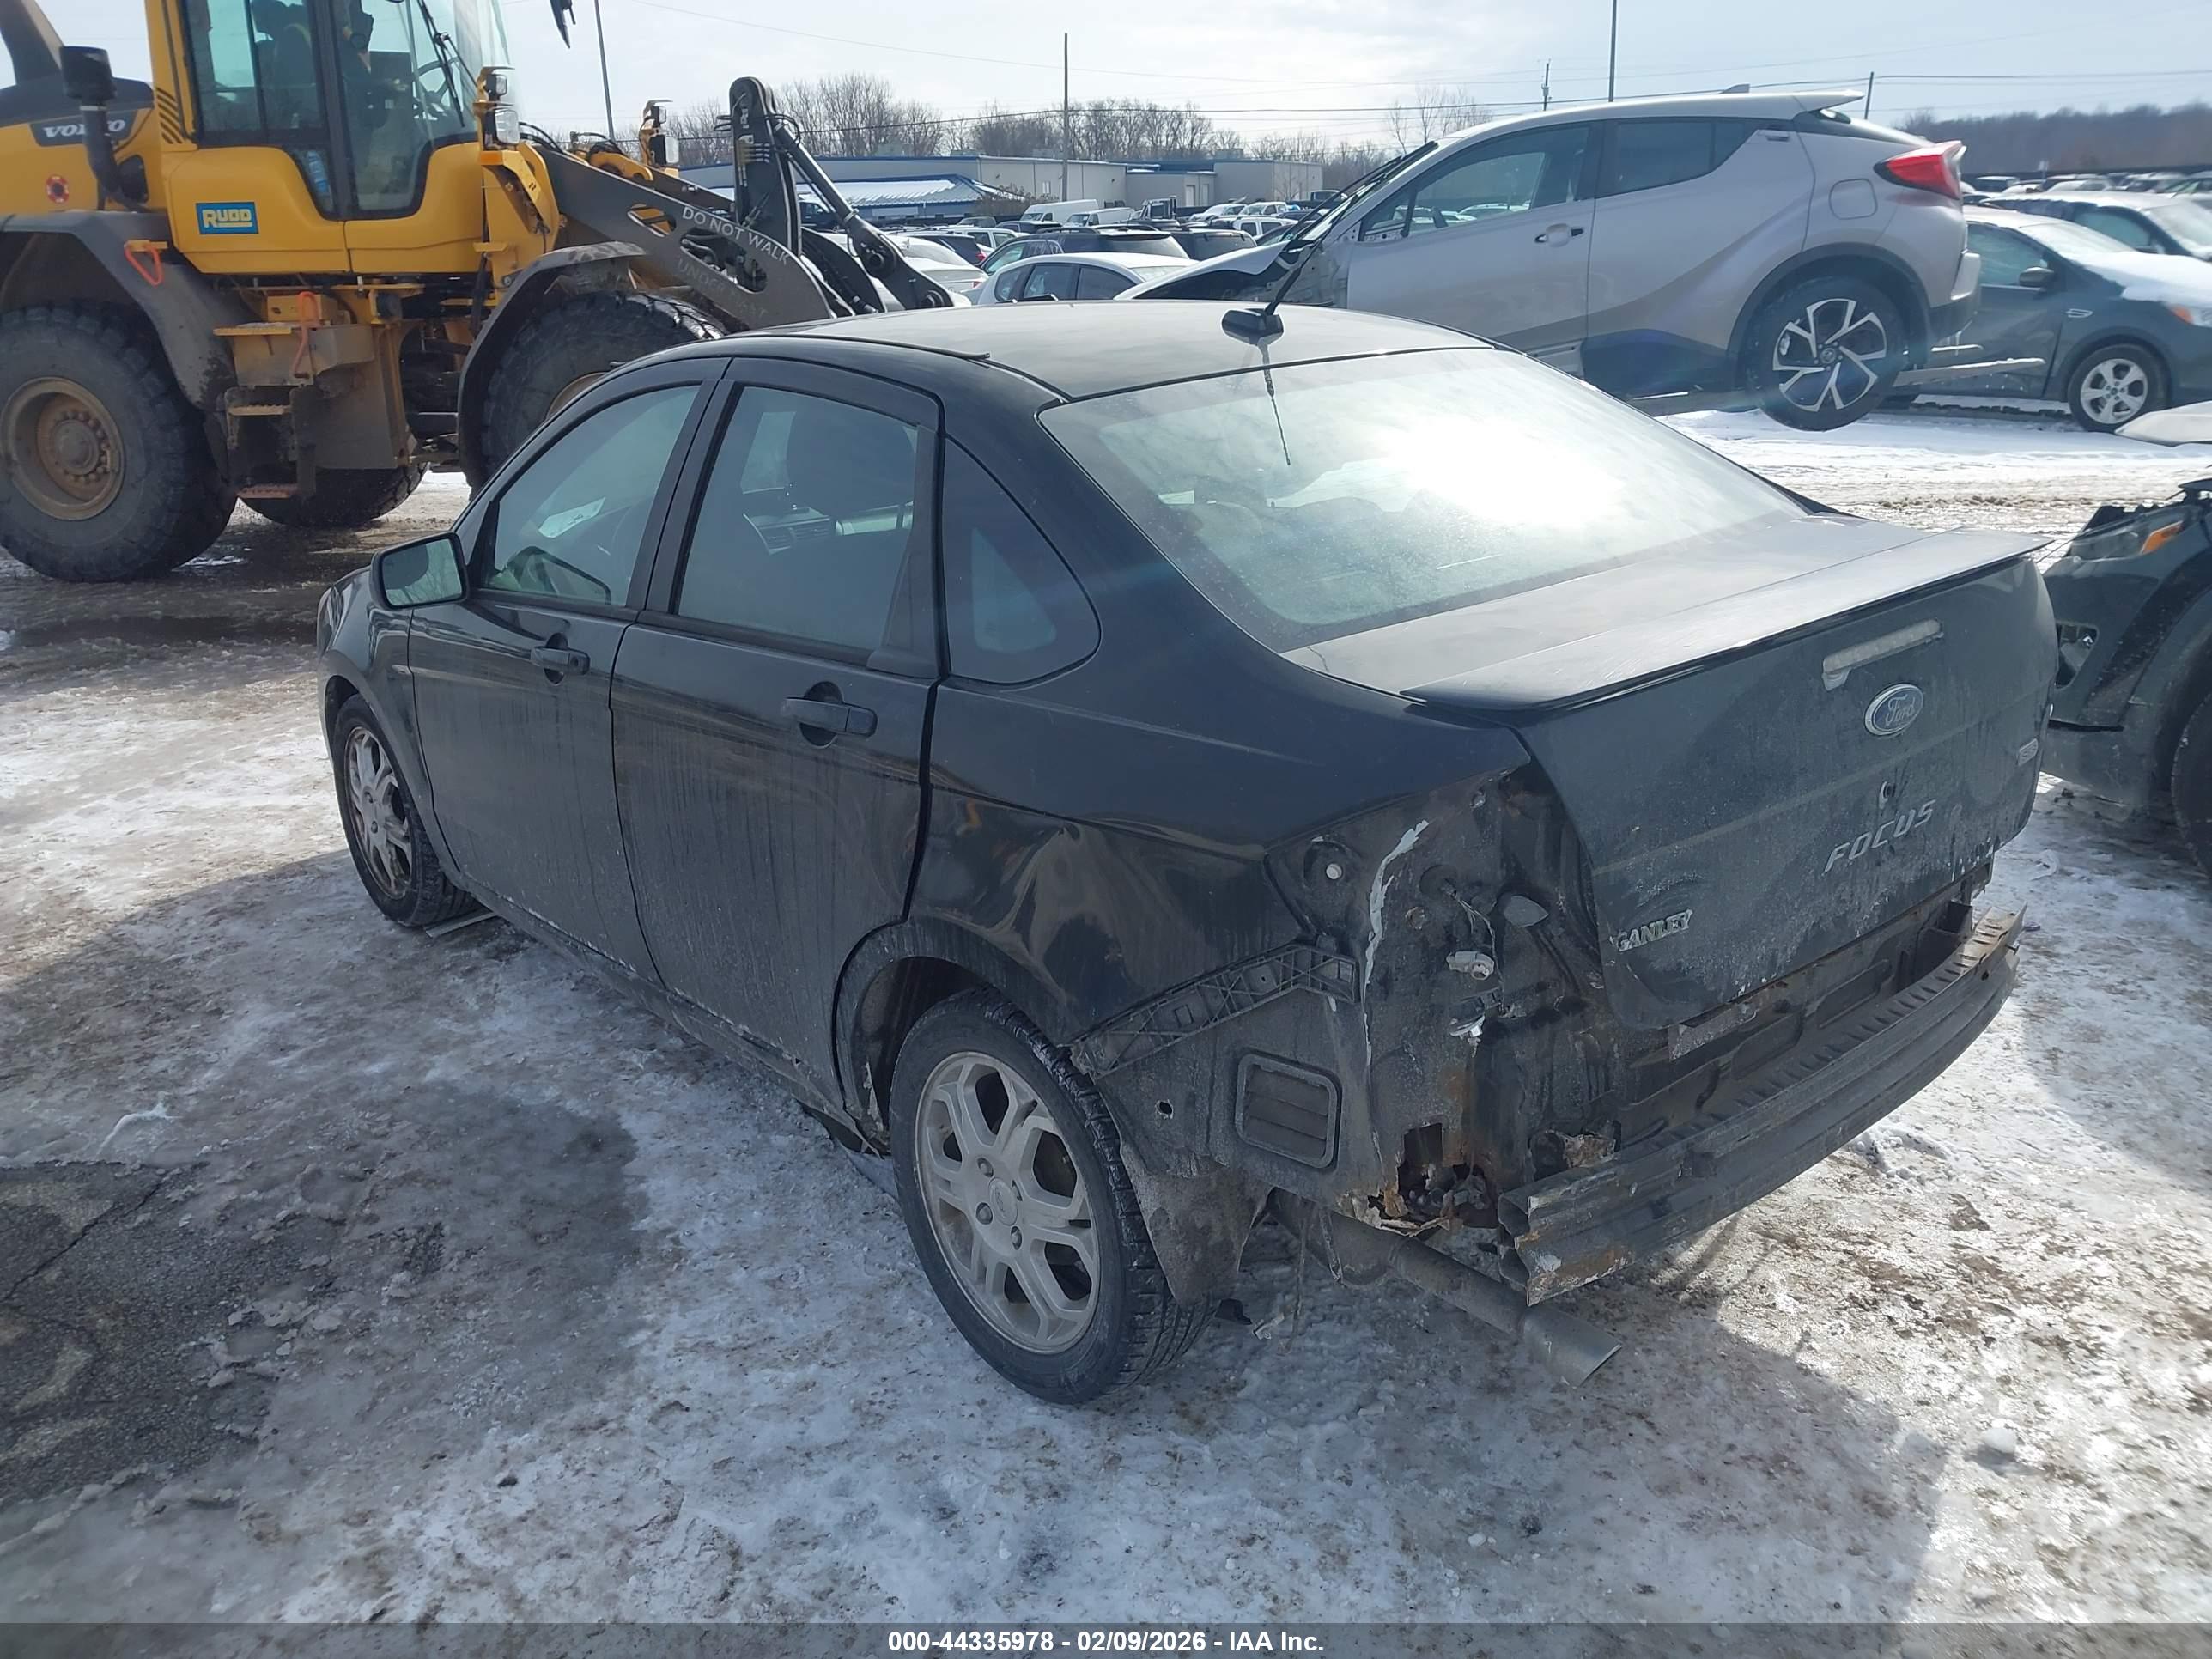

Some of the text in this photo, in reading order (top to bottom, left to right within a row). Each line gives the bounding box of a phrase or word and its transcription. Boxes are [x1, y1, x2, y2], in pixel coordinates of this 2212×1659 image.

[43, 119, 125, 138] VOLO
[202, 209, 252, 228] RUDD
[682, 206, 790, 265] DO NOT WALK
[1885, 693, 1916, 726] Ford
[1824, 799, 1936, 873] FOCUS
[1616, 908, 1693, 952] GANLEY
